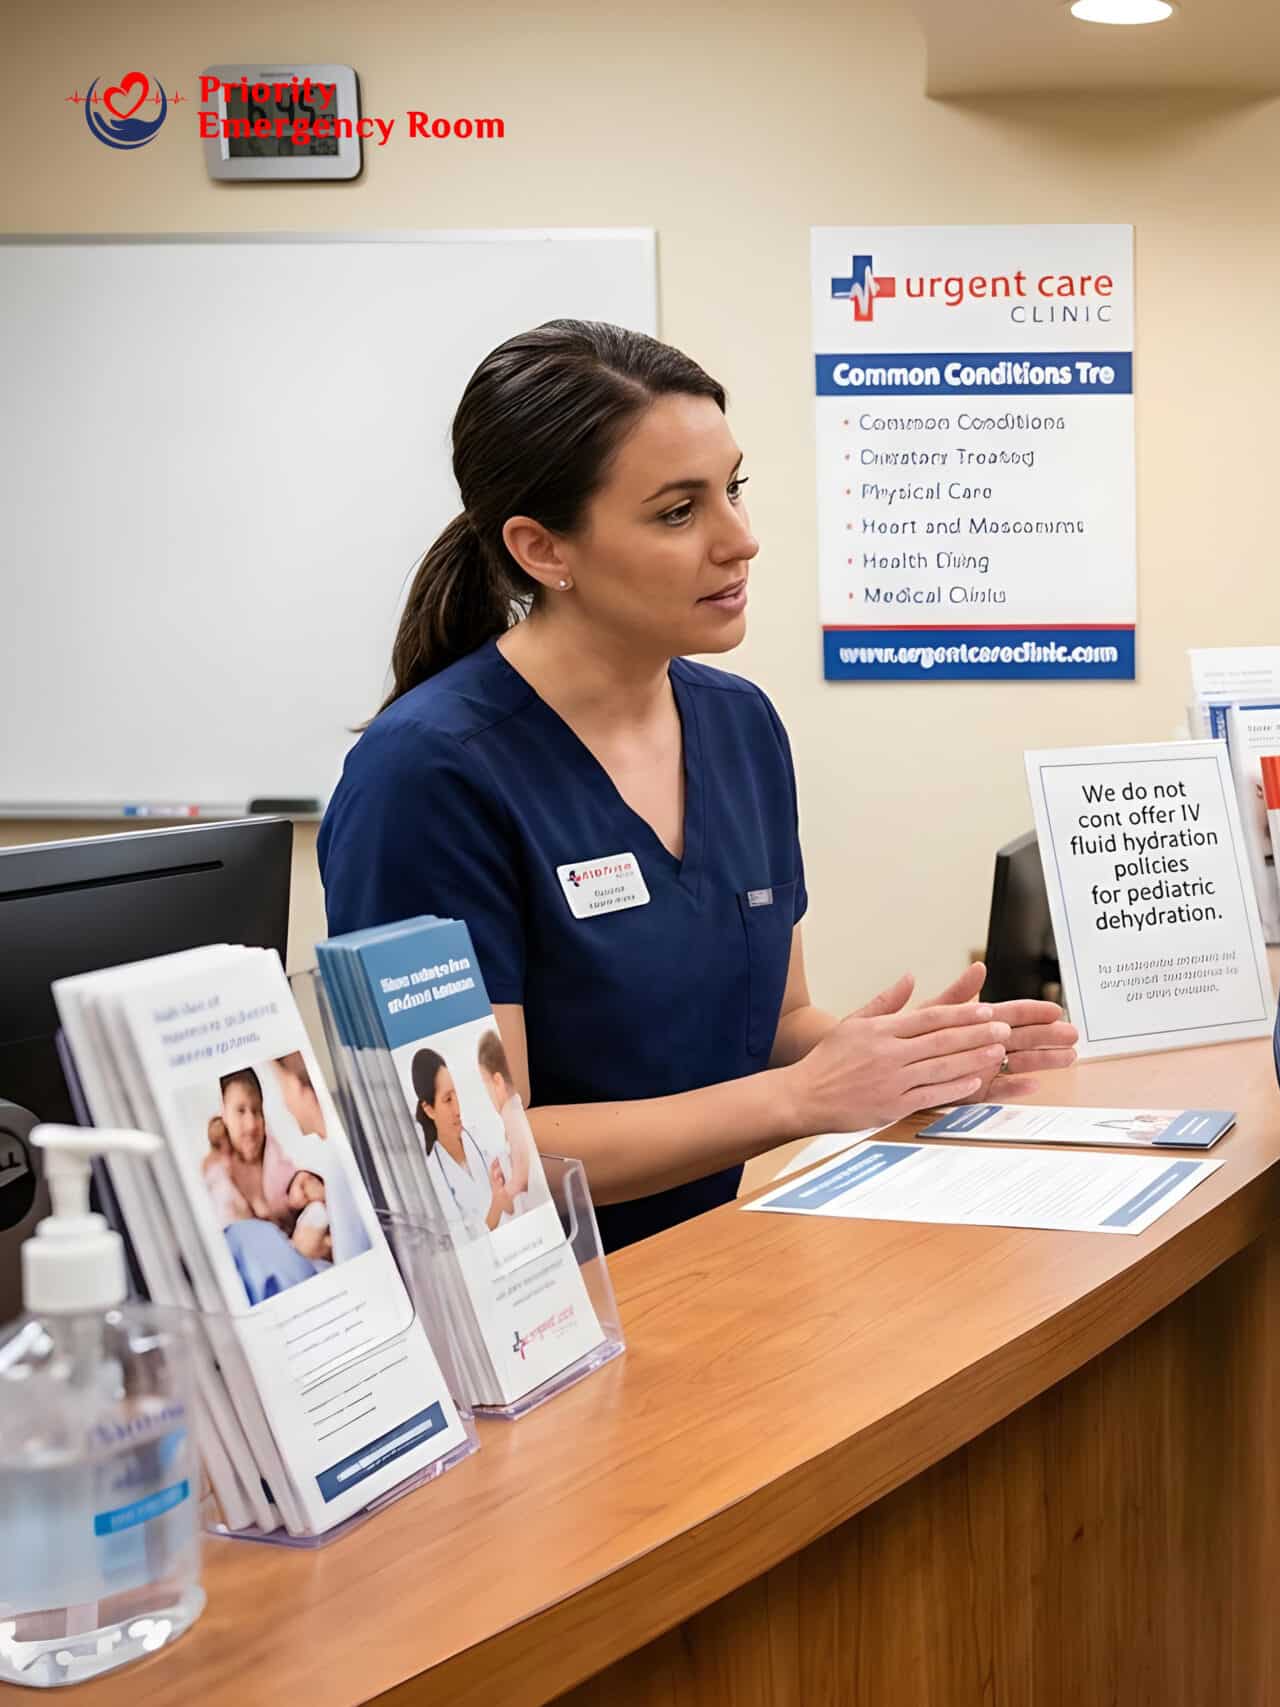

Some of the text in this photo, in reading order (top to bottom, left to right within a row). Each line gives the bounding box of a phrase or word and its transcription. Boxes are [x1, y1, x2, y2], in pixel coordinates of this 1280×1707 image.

[906, 271, 1113, 305] urgent care
[1011, 305, 1112, 323] CLINIC
[833, 363, 940, 386] Common
[944, 362, 1072, 385] Conditions
[925, 517, 961, 534] and
[1082, 780, 1187, 804] We do not
[1078, 803, 1201, 828] cont offer IV
[1070, 829, 1218, 855] fluid hydration
[1091, 877, 1216, 905] for pediatric
[1095, 904, 1223, 932] dehydration.
